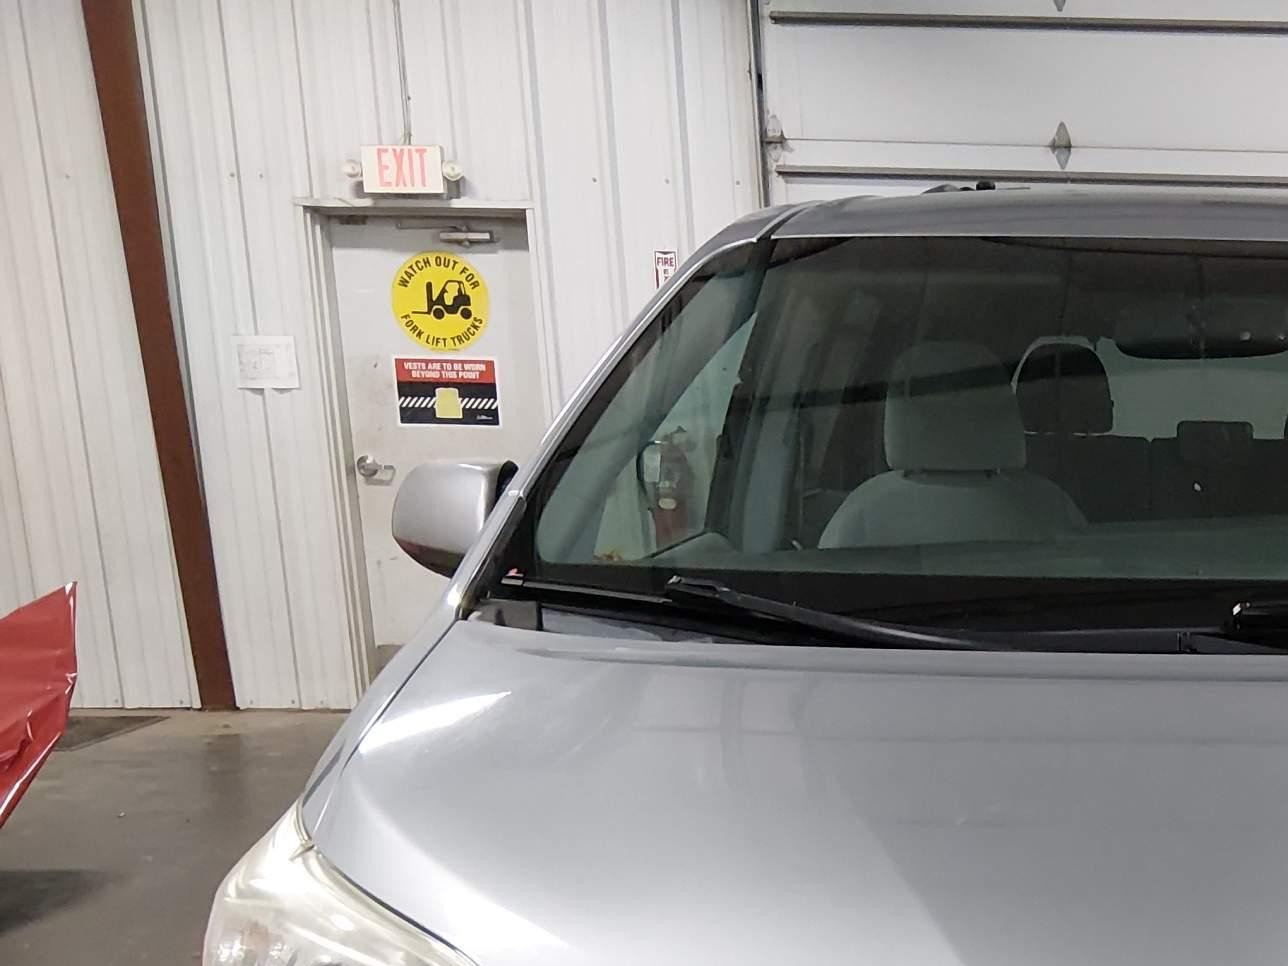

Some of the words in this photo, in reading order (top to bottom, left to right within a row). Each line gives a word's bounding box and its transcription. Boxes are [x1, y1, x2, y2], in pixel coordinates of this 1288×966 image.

[376, 147, 427, 188] EXIT
[398, 256, 431, 288] WATCH
[434, 255, 459, 271] OUT
[459, 266, 480, 290] FOR
[657, 257, 674, 267] FIRE
[400, 313, 425, 340] FORK
[425, 334, 448, 348] LIFT
[449, 316, 483, 347] TRUCKS
[428, 362, 441, 370] ARE
[442, 371, 457, 379] THIS
[459, 371, 479, 379] POINT
